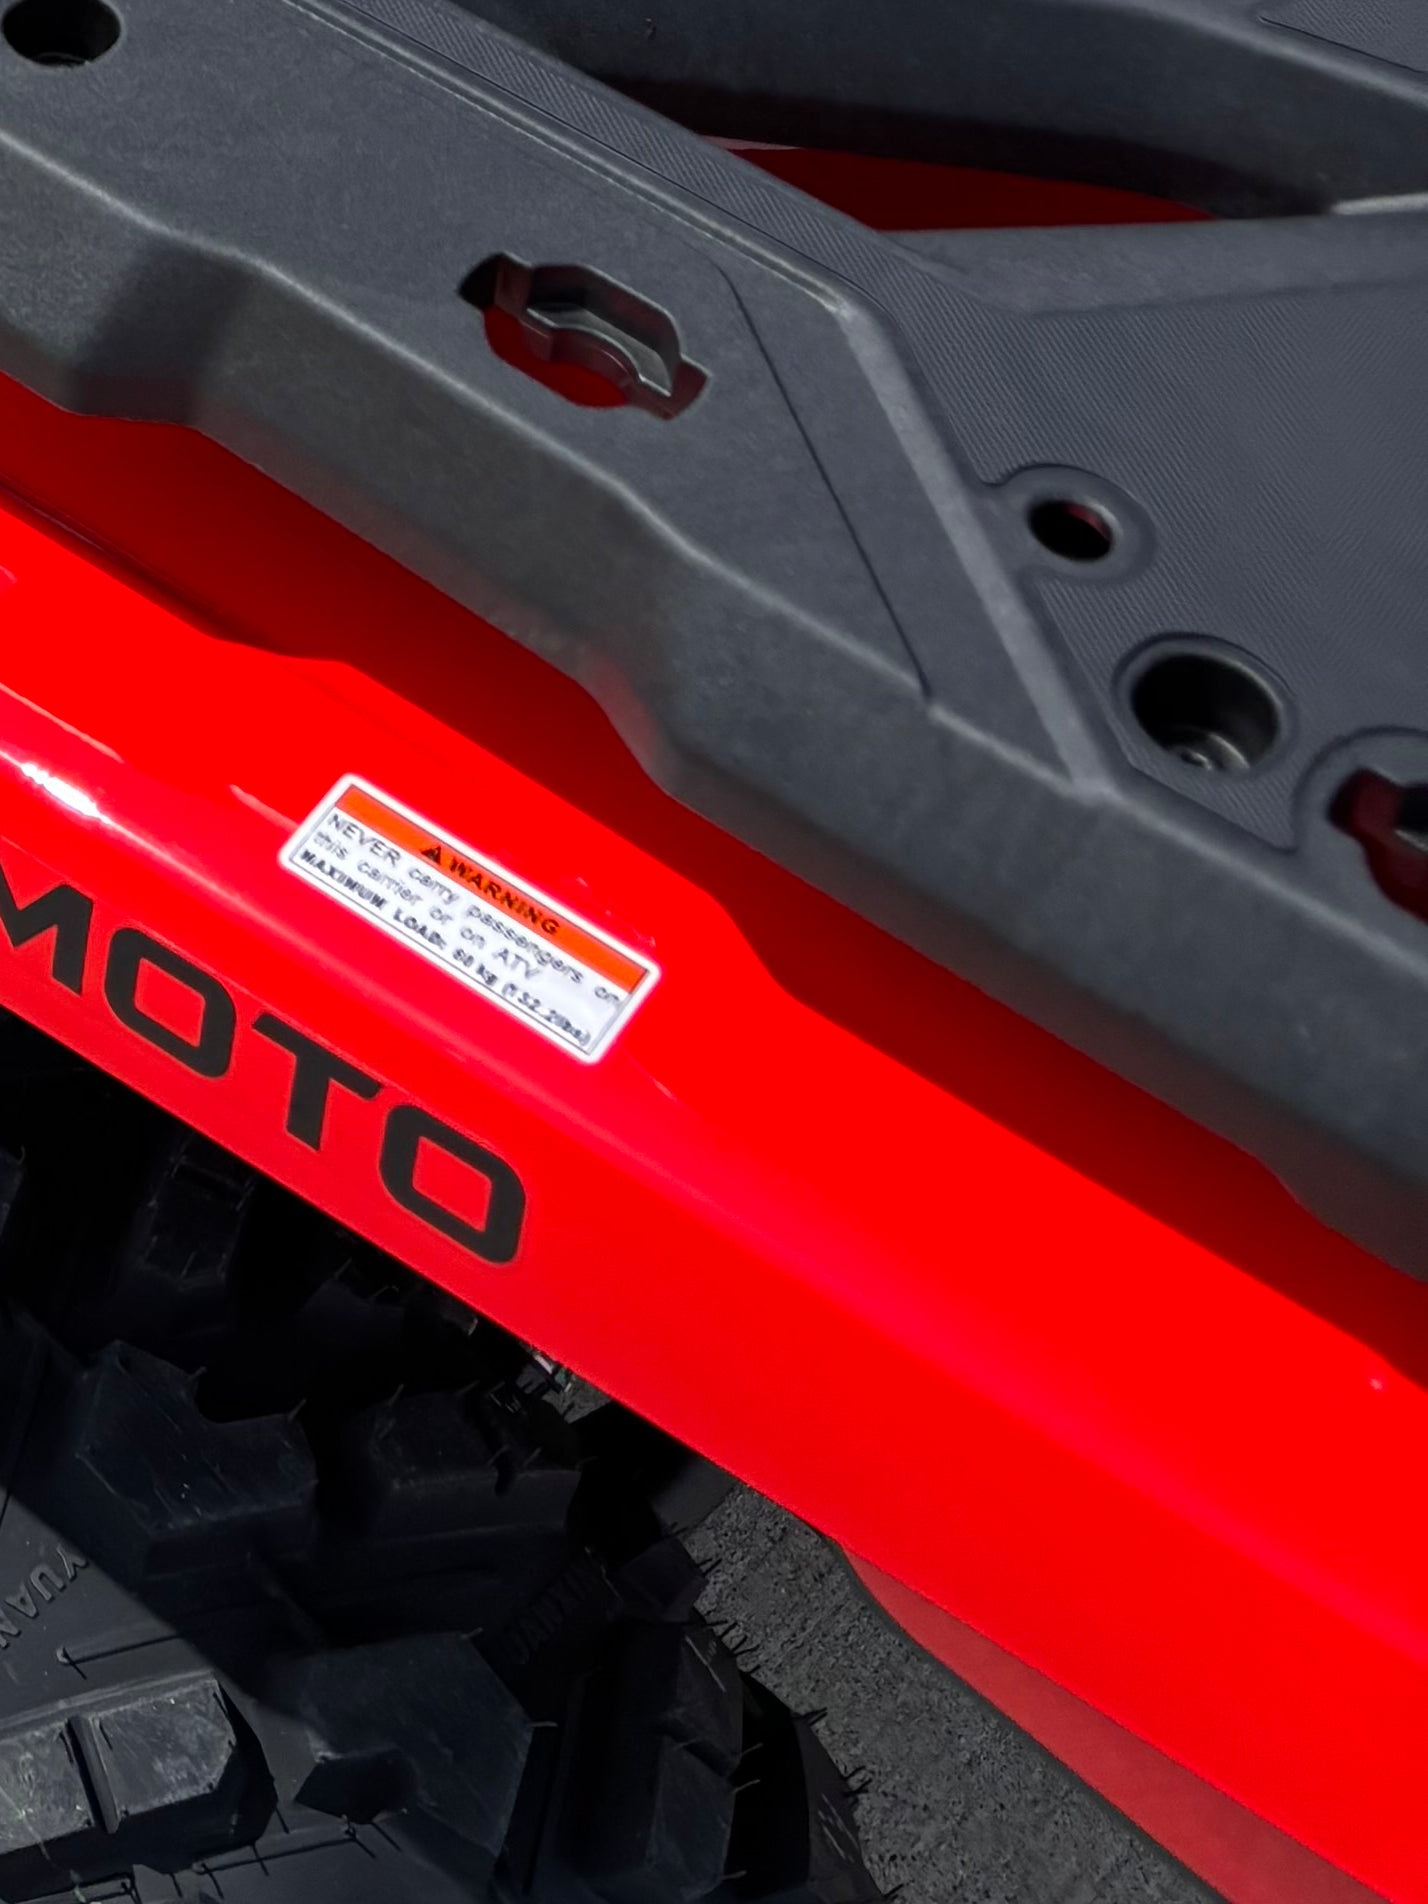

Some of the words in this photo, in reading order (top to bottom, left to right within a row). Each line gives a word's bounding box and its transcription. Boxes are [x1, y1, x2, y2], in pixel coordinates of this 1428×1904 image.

[296, 848, 387, 912] MAXIMUM
[310, 830, 351, 862] this
[354, 858, 425, 909] carrier
[491, 944, 542, 984] ATV
[325, 813, 404, 868] NEVER
[404, 865, 460, 907] carry
[462, 901, 587, 987] passengers
[443, 856, 563, 937] WARNING
